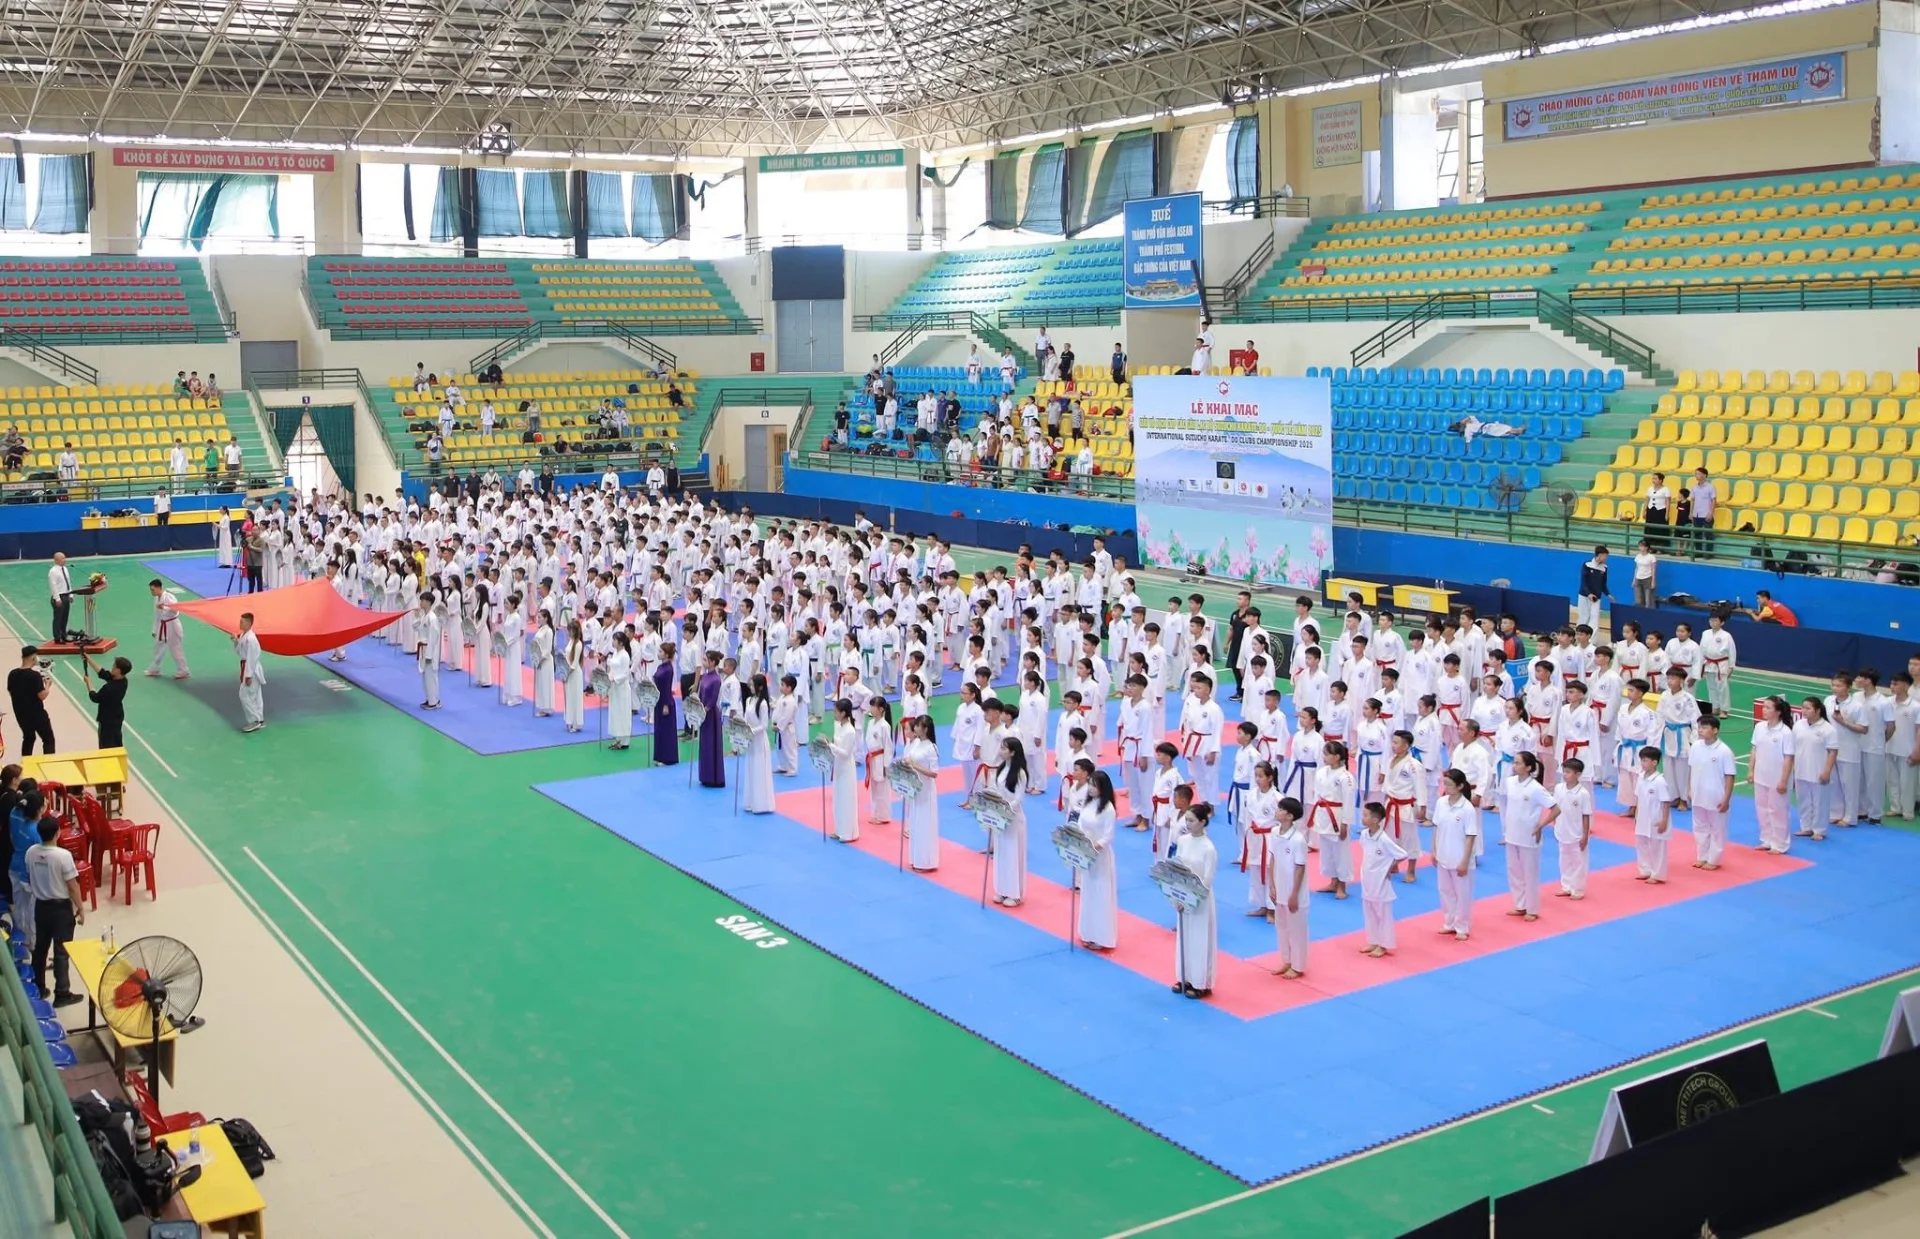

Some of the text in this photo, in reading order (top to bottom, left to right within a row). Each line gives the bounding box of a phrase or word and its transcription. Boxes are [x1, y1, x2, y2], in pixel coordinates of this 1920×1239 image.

[1747, 67, 1778, 83] THAM
[766, 157, 795, 170] NHANH
[822, 155, 838, 167] CAO
[864, 153, 877, 165] XA
[1151, 203, 1171, 221] HUẾ
[1206, 402, 1231, 415] KHAI
[1234, 403, 1259, 418] MẠC
[1146, 432, 1184, 441] INTERNATIONAL
[1208, 435, 1228, 443] KARATE
[1240, 436, 1256, 445] CLUBS
[1256, 437, 1298, 448] CHAMPIONSHIP
[1299, 440, 1313, 449] 2025
[755, 937, 789, 949] 3
